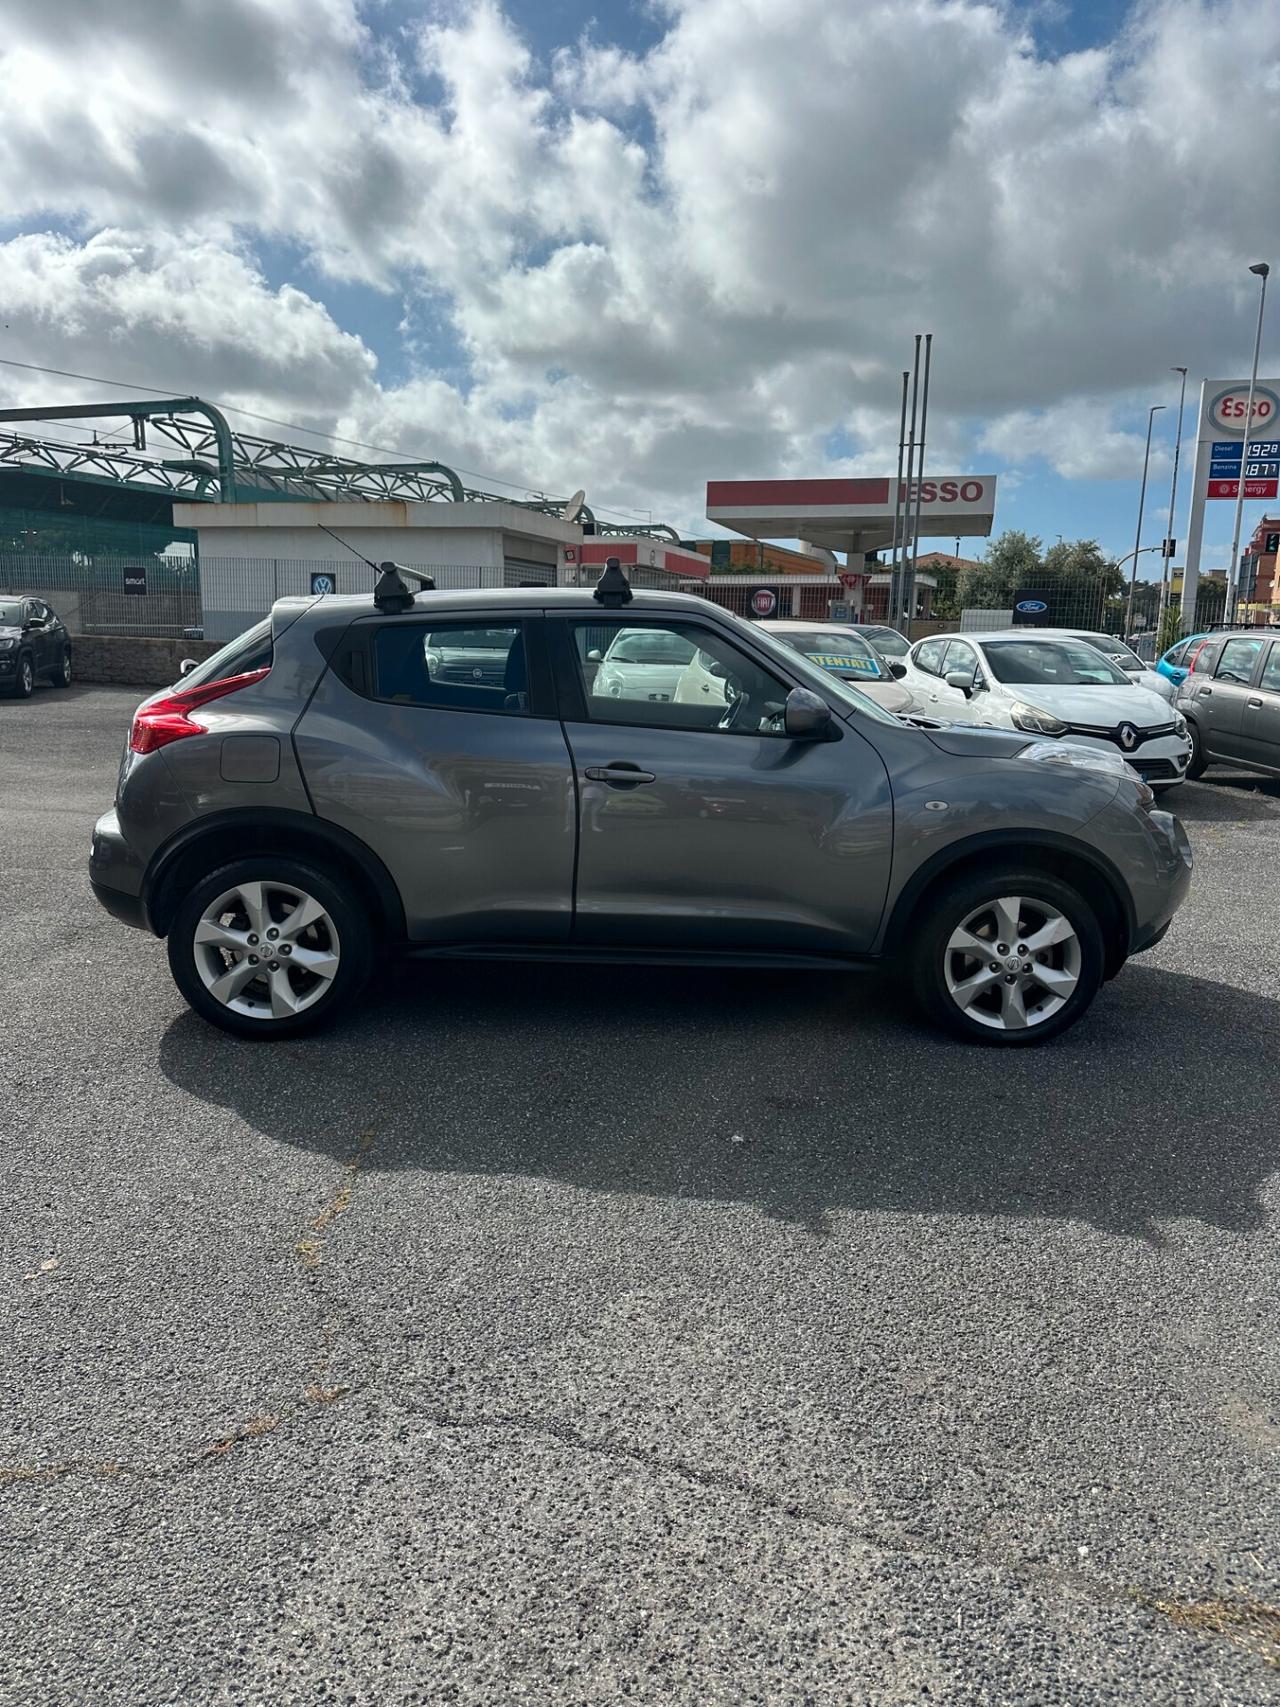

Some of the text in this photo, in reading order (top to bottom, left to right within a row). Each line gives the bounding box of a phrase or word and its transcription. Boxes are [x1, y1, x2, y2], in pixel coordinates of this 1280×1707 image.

[898, 481, 984, 503] ESSO
[1232, 484, 1267, 495] Snergy
[125, 577, 145, 585] smart
[756, 597, 771, 609] FIAT
